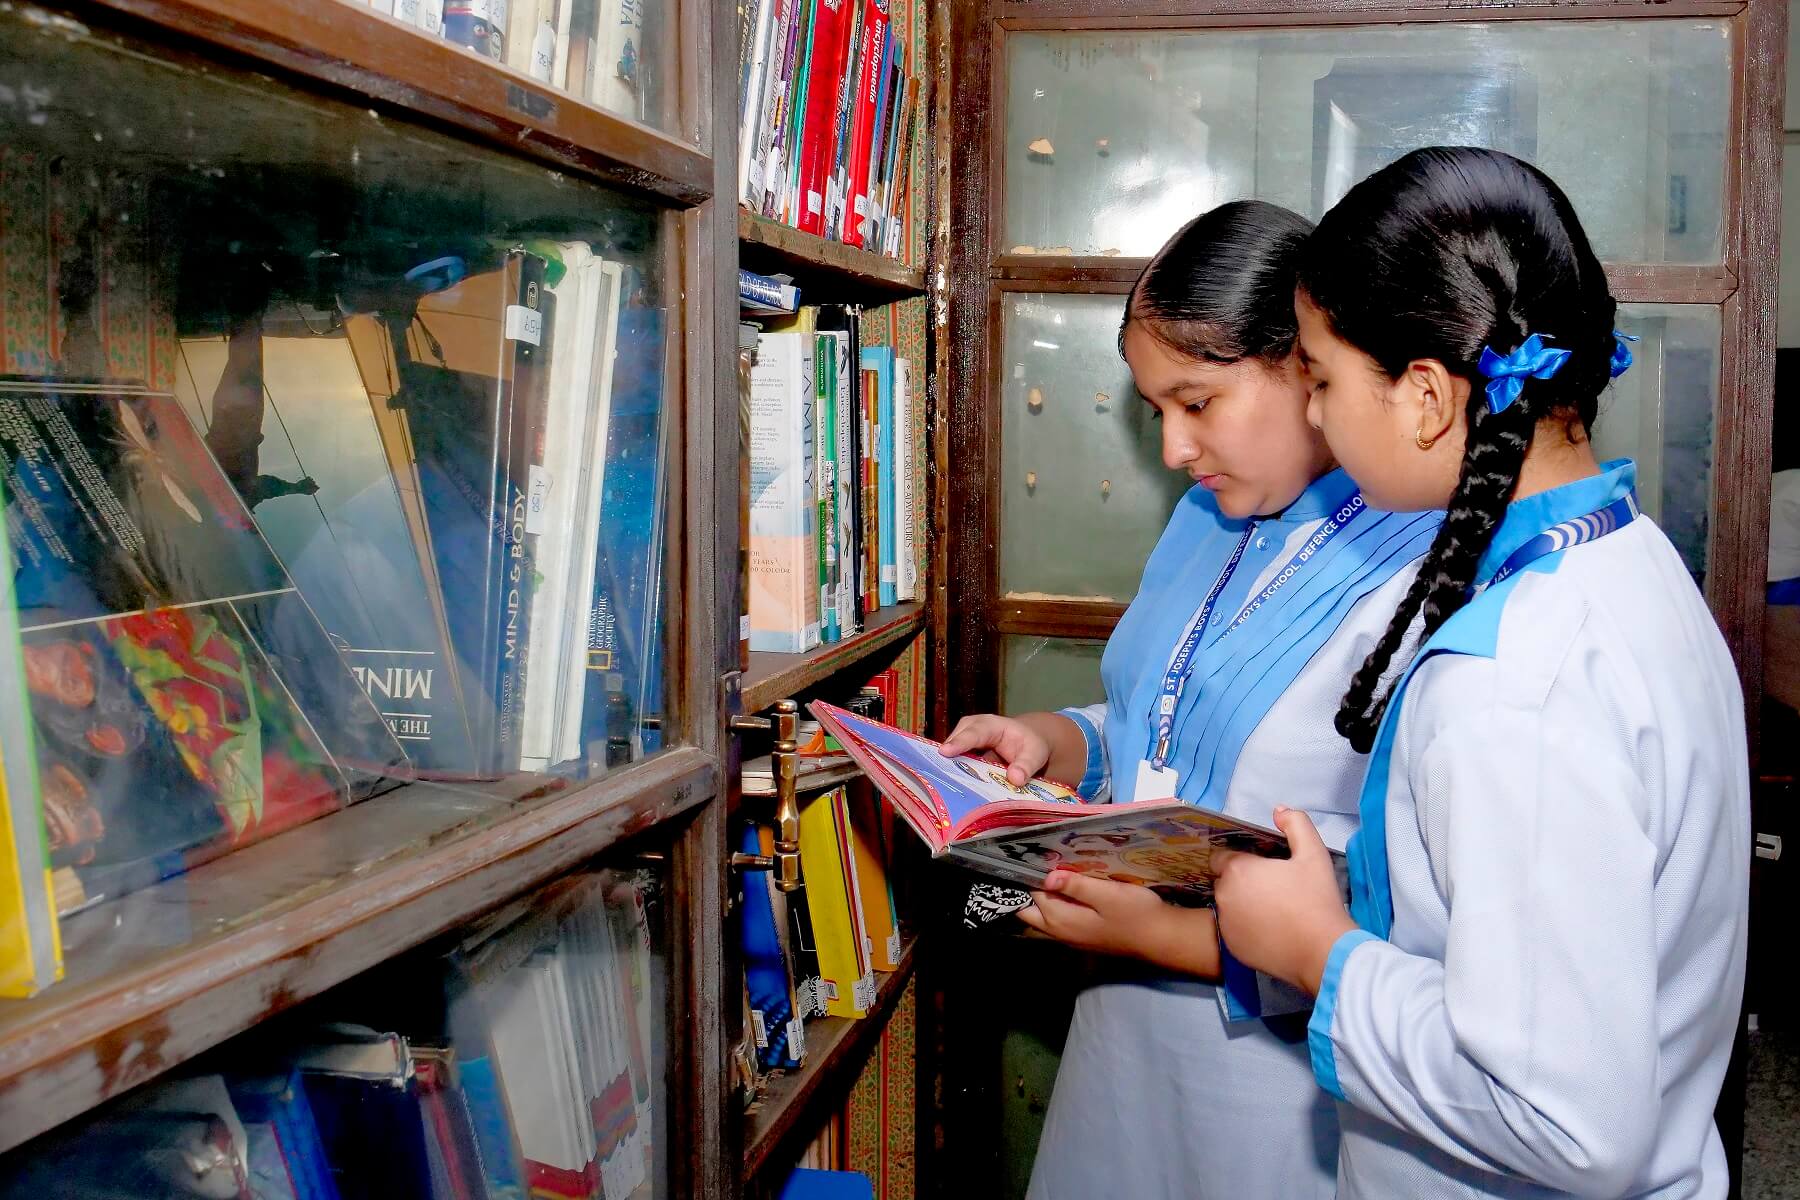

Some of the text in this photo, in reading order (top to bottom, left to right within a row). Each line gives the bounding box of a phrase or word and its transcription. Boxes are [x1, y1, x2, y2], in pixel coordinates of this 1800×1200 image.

[869, 19, 882, 103] encyclopaedia
[511, 486, 526, 558] BODY
[1262, 563, 1302, 600] SCHOOL,
[1299, 520, 1339, 562] DEFENCE
[1336, 493, 1363, 523] COLO
[510, 563, 521, 582] &
[505, 590, 520, 659] MIND
[597, 595, 608, 649] GEOGRAPHIC
[605, 614, 616, 649] SOCIETY
[1170, 633, 1198, 675] JOSEPH'S
[1166, 676, 1177, 691] ST.
[400, 719, 431, 735] THE
